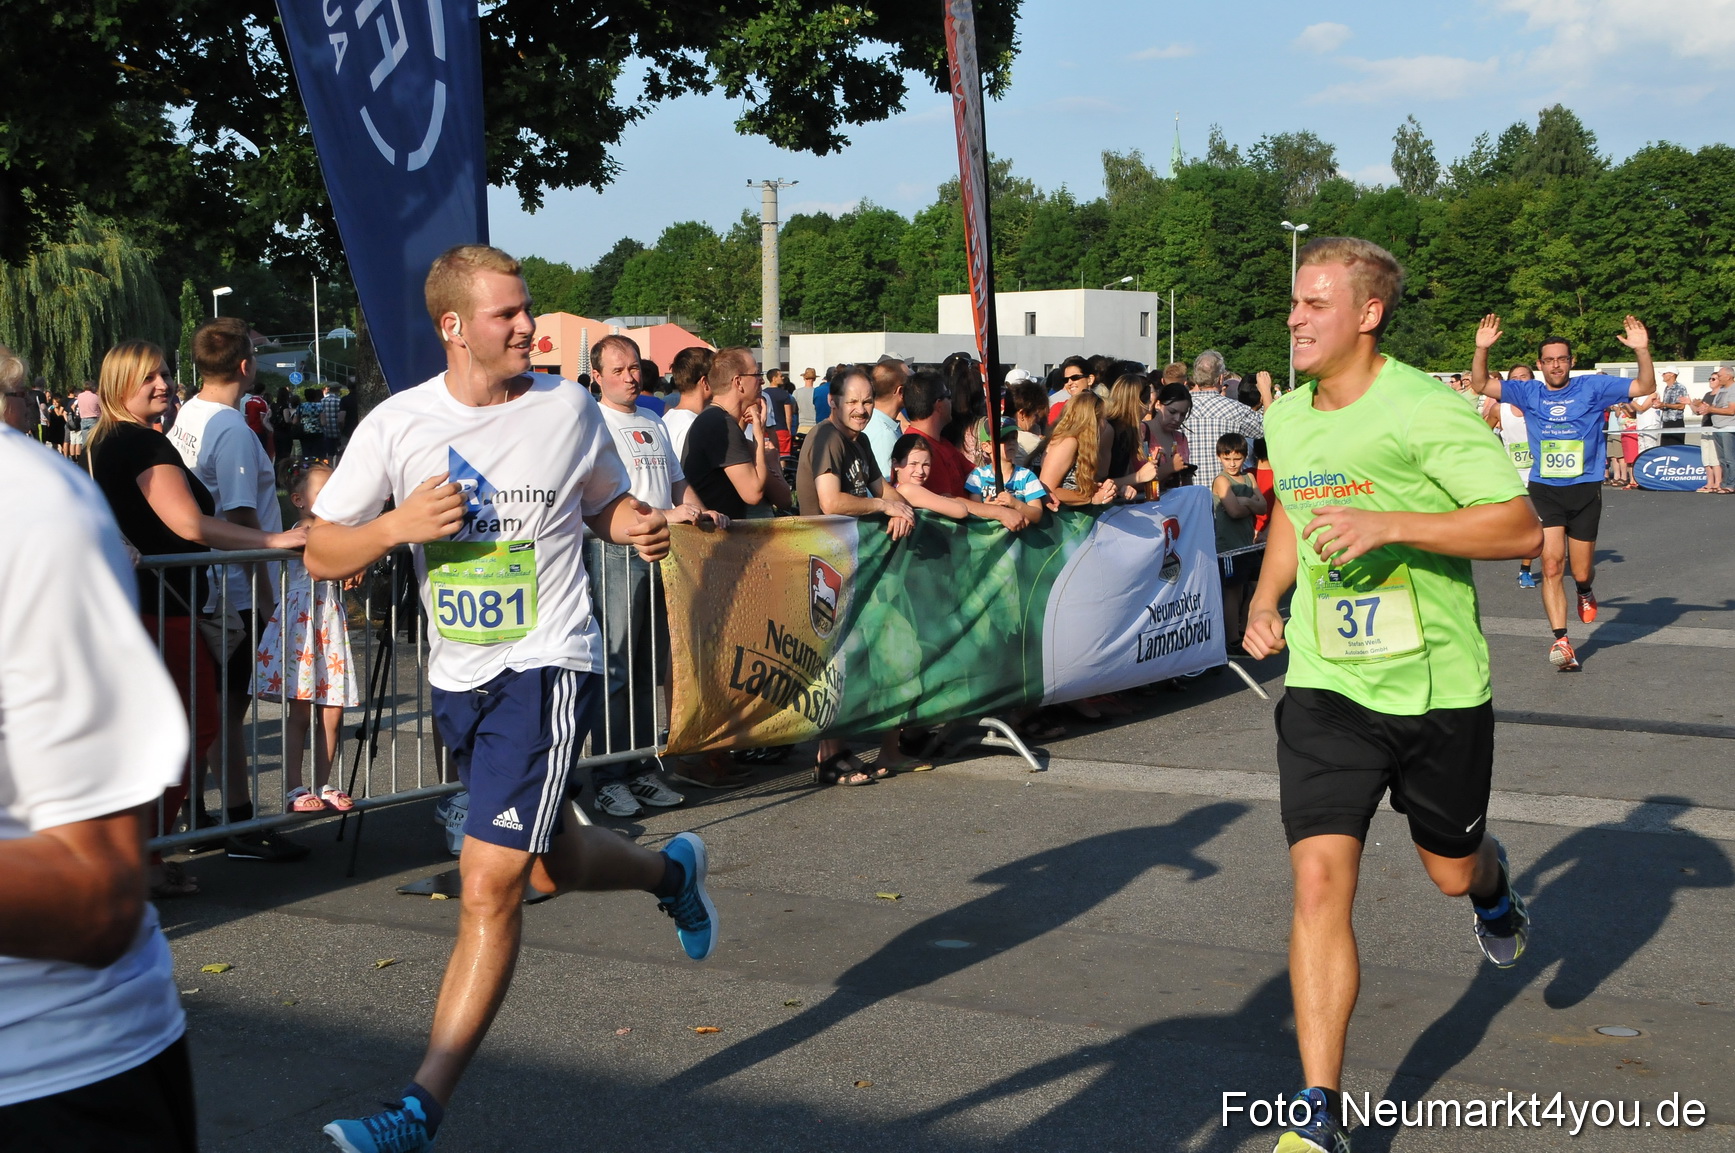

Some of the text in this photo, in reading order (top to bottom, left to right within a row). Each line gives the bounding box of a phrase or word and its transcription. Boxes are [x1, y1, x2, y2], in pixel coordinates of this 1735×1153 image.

[1546, 453, 1576, 469] 996
[1655, 465, 1707, 477] Fische
[463, 513, 523, 535] Team
[438, 588, 525, 629] 5081
[1146, 591, 1202, 625] Neumarkter
[1335, 596, 1381, 639] 37
[1136, 612, 1211, 664] Lammsbräu
[765, 618, 845, 695] Neumarkte
[492, 817, 524, 831] adidas
